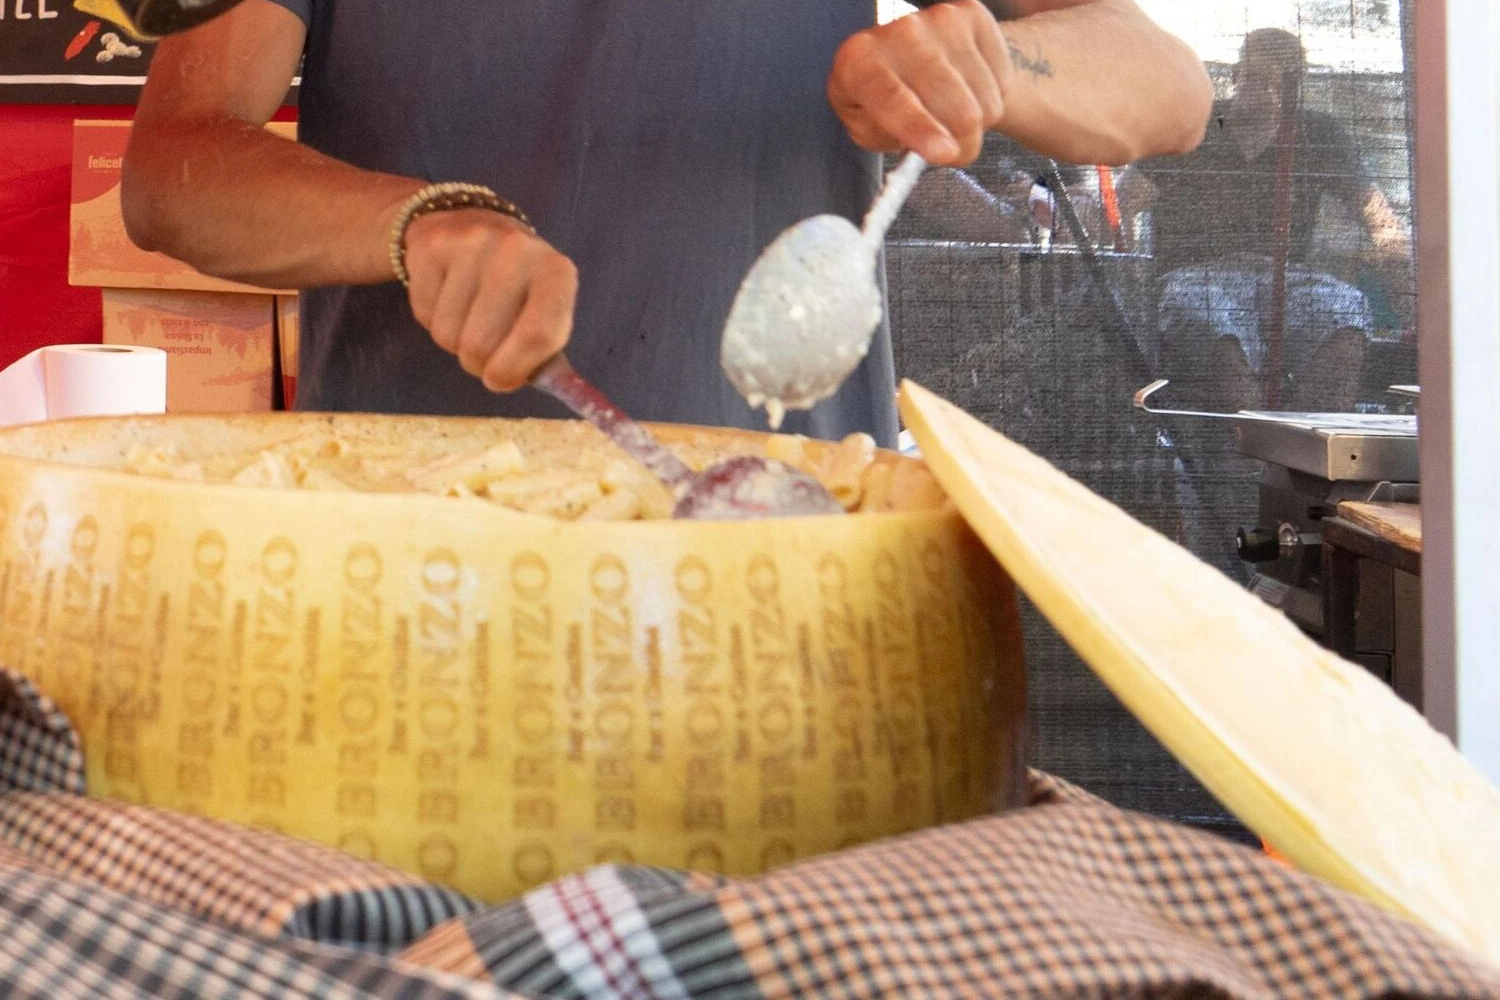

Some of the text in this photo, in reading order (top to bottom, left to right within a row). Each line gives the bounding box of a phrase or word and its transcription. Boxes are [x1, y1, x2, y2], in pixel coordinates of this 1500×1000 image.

[176, 531, 227, 797] BRONZO
[249, 538, 298, 807] BRONZO
[336, 545, 383, 818] BRONZO
[416, 551, 461, 825] BRONZO
[510, 553, 556, 829] BRONZO
[589, 554, 636, 831] BRONZO
[675, 555, 726, 834] BRONZO
[745, 554, 796, 829] BRONZO
